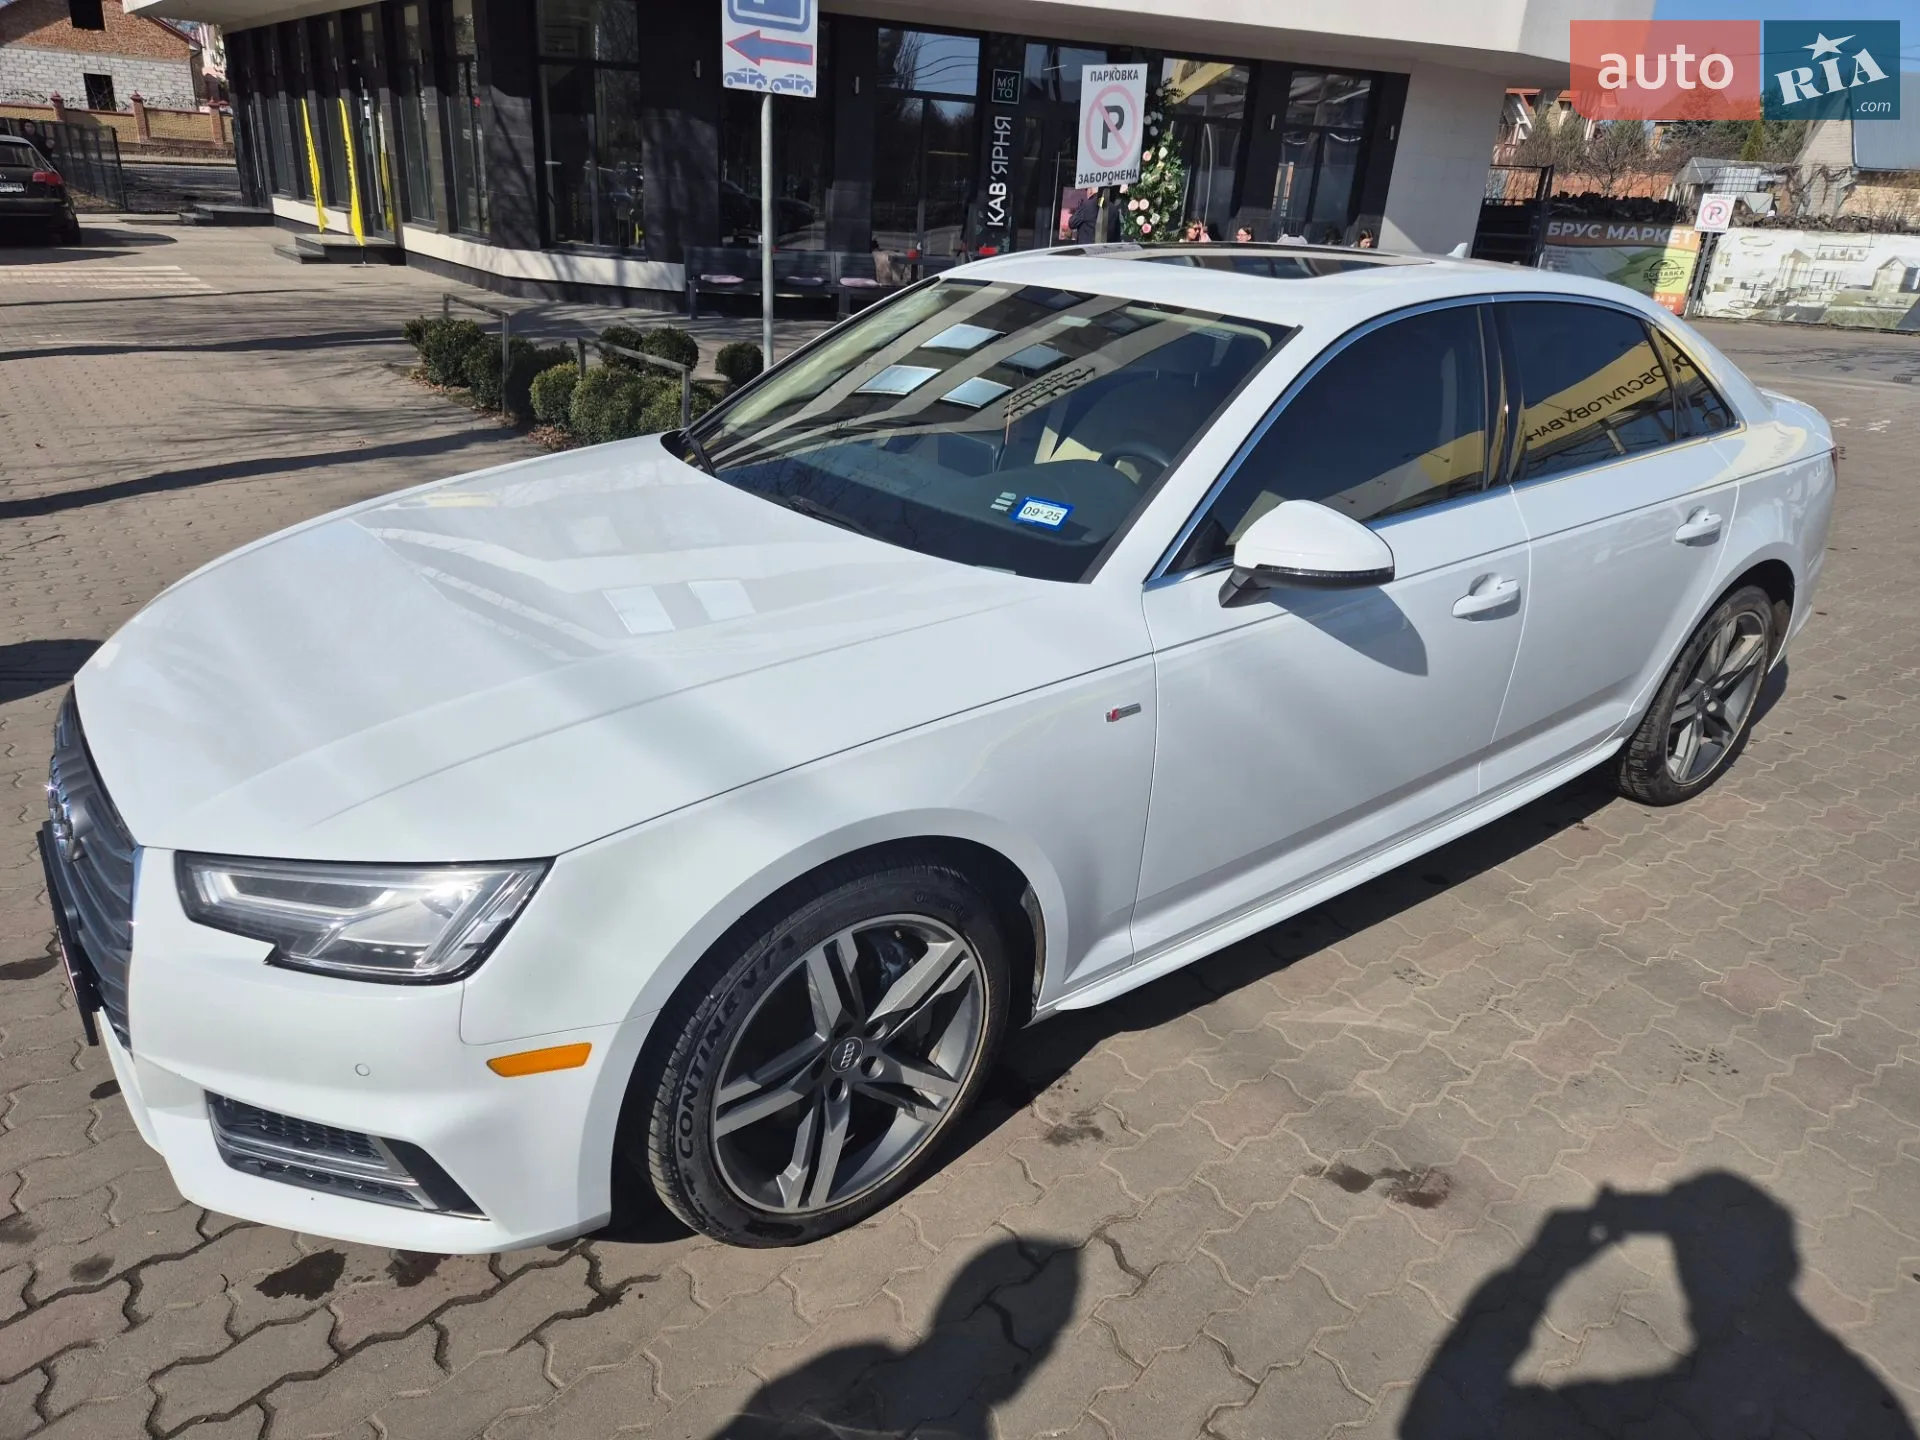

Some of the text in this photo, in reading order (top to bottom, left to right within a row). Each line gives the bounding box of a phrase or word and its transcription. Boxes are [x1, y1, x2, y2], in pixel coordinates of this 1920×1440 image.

[1090, 69, 1139, 82] ПАРКОВКА
[987, 116, 1012, 226] КАВ'ЯРНЯ
[1078, 168, 1138, 185] ЗАБОРОНЕНА
[1547, 221, 1694, 243] БРУС МАРКЕТ
